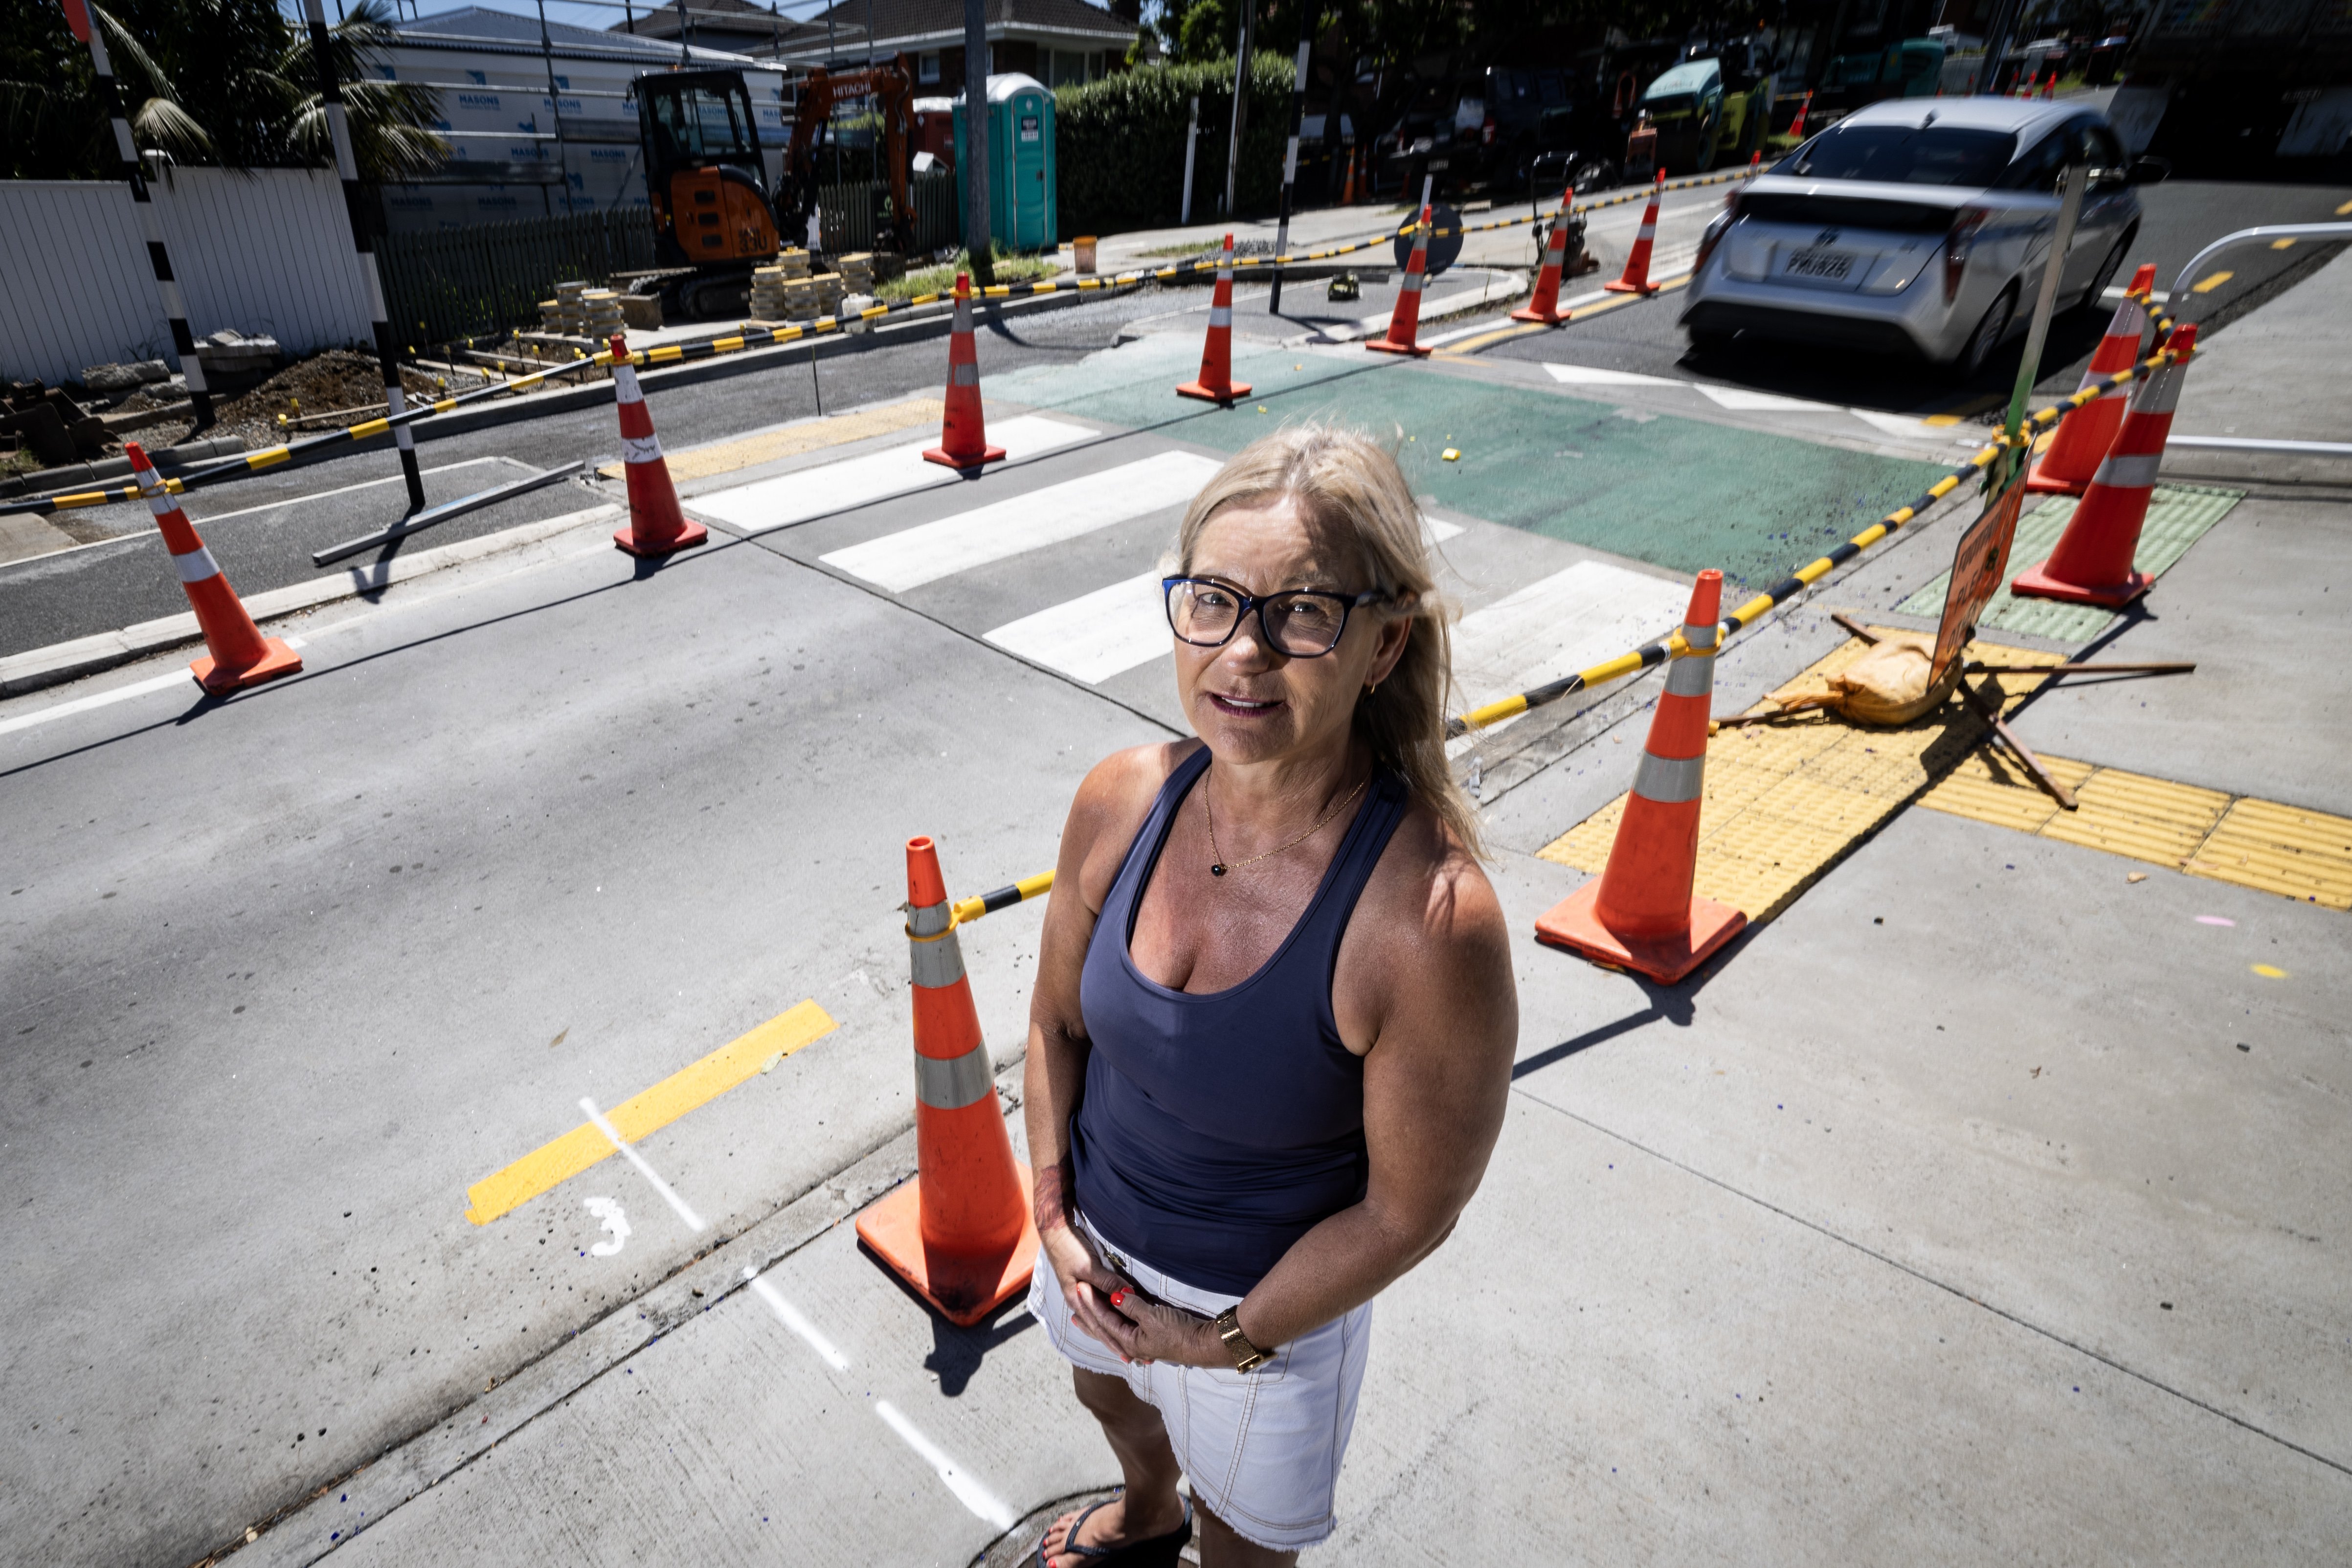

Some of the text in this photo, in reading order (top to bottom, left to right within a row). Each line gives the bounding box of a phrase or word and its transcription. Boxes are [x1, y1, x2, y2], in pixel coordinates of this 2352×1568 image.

[833, 80, 871, 99] HITACHI
[458, 94, 499, 106] MASONS
[543, 98, 581, 109] MSONS
[590, 149, 626, 159] MASONS
[391, 197, 432, 206] MASONS
[477, 197, 516, 206] MASONS
[558, 197, 594, 205] MSONS
